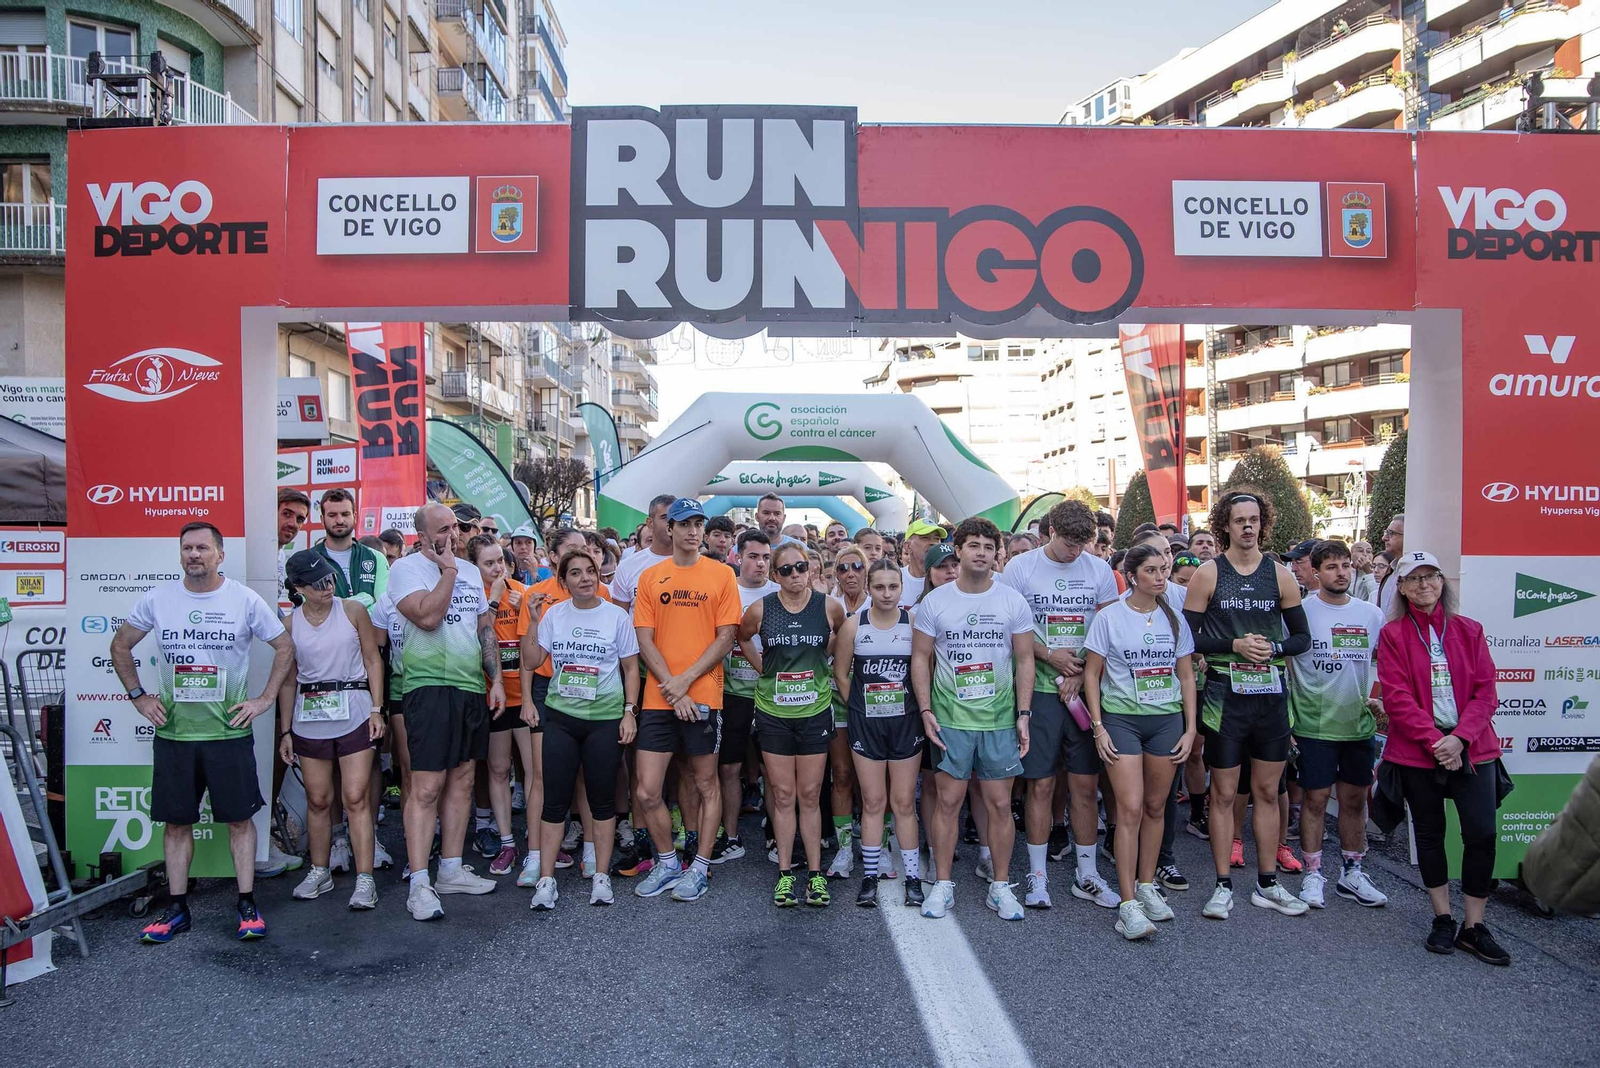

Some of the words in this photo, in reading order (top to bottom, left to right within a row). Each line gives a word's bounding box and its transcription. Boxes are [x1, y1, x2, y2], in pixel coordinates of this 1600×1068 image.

[586, 118, 846, 208] RUN
[86, 180, 213, 226] VIGO
[328, 193, 457, 213] CONCELLO
[1184, 196, 1309, 216] CONCELLO
[1437, 186, 1567, 232] VIGO
[344, 219, 374, 237] DE
[383, 217, 441, 236] VIGO
[1200, 221, 1230, 239] DE
[1238, 220, 1295, 239] VIGO
[94, 221, 268, 257] DEPORTE
[1448, 228, 1600, 262] DEPORT
[88, 368, 132, 382] Frutas
[177, 367, 220, 382] Nieves
[0, 384, 23, 394] Vigo
[3, 394, 34, 402] contra
[46, 394, 66, 402] can
[790, 405, 847, 414] asociación
[790, 416, 839, 427] española
[790, 429, 825, 438] contra
[828, 428, 837, 438] el
[840, 428, 876, 438] cáncer
[317, 458, 333, 466] RUN
[739, 472, 750, 484] El
[751, 473, 774, 484] Corte
[775, 471, 812, 487] Inglés
[129, 486, 225, 502] HYUNDAI
[145, 507, 187, 516] Hyupersa
[189, 507, 209, 517] Vigo
[1540, 506, 1583, 516] Hyupersa
[18, 543, 58, 551] EROSKI
[1413, 553, 1425, 561] E
[80, 573, 126, 581] OMODA
[134, 573, 180, 581] JAECOO
[98, 585, 156, 593] resnovamot
[1033, 594, 1049, 604] En
[1052, 594, 1095, 604] Marcha
[1516, 589, 1526, 600] El
[1526, 590, 1547, 600] Corte
[1546, 588, 1578, 603] Inglés
[1220, 596, 1244, 609] máis
[1252, 600, 1276, 611] auga
[162, 629, 178, 640] En
[183, 629, 236, 641] Marcha
[945, 630, 960, 640] En
[963, 629, 1004, 640] Marcha
[1056, 626, 1077, 634] 1097
[767, 634, 791, 647] máis
[799, 635, 824, 647] auga
[1312, 640, 1328, 650] En
[1339, 638, 1362, 646] 3536
[1485, 635, 1541, 648] Starnaliza
[1544, 636, 1600, 646] LASERGA
[552, 641, 564, 650] En
[566, 641, 606, 654] Marcha
[947, 650, 973, 663] Vigo
[1123, 650, 1138, 660] En
[1140, 649, 1178, 660] March
[737, 660, 753, 668] 152
[1312, 660, 1343, 674] Vigo
[1241, 674, 1263, 682] 3621
[1544, 666, 1575, 680] máis
[182, 677, 208, 687] 2550
[567, 675, 589, 685] 2812
[964, 674, 987, 685] 1906
[1145, 680, 1165, 689] 1096
[785, 683, 807, 692] 1905
[873, 694, 896, 703] 1904
[1498, 699, 1547, 708] KODA
[135, 725, 155, 735] ICS
[1540, 737, 1585, 746] RODOSA
[1502, 810, 1555, 820] asociación
[1501, 822, 1533, 831] contra
[1501, 835, 1514, 843] en
[1515, 833, 1537, 844] Vigo
